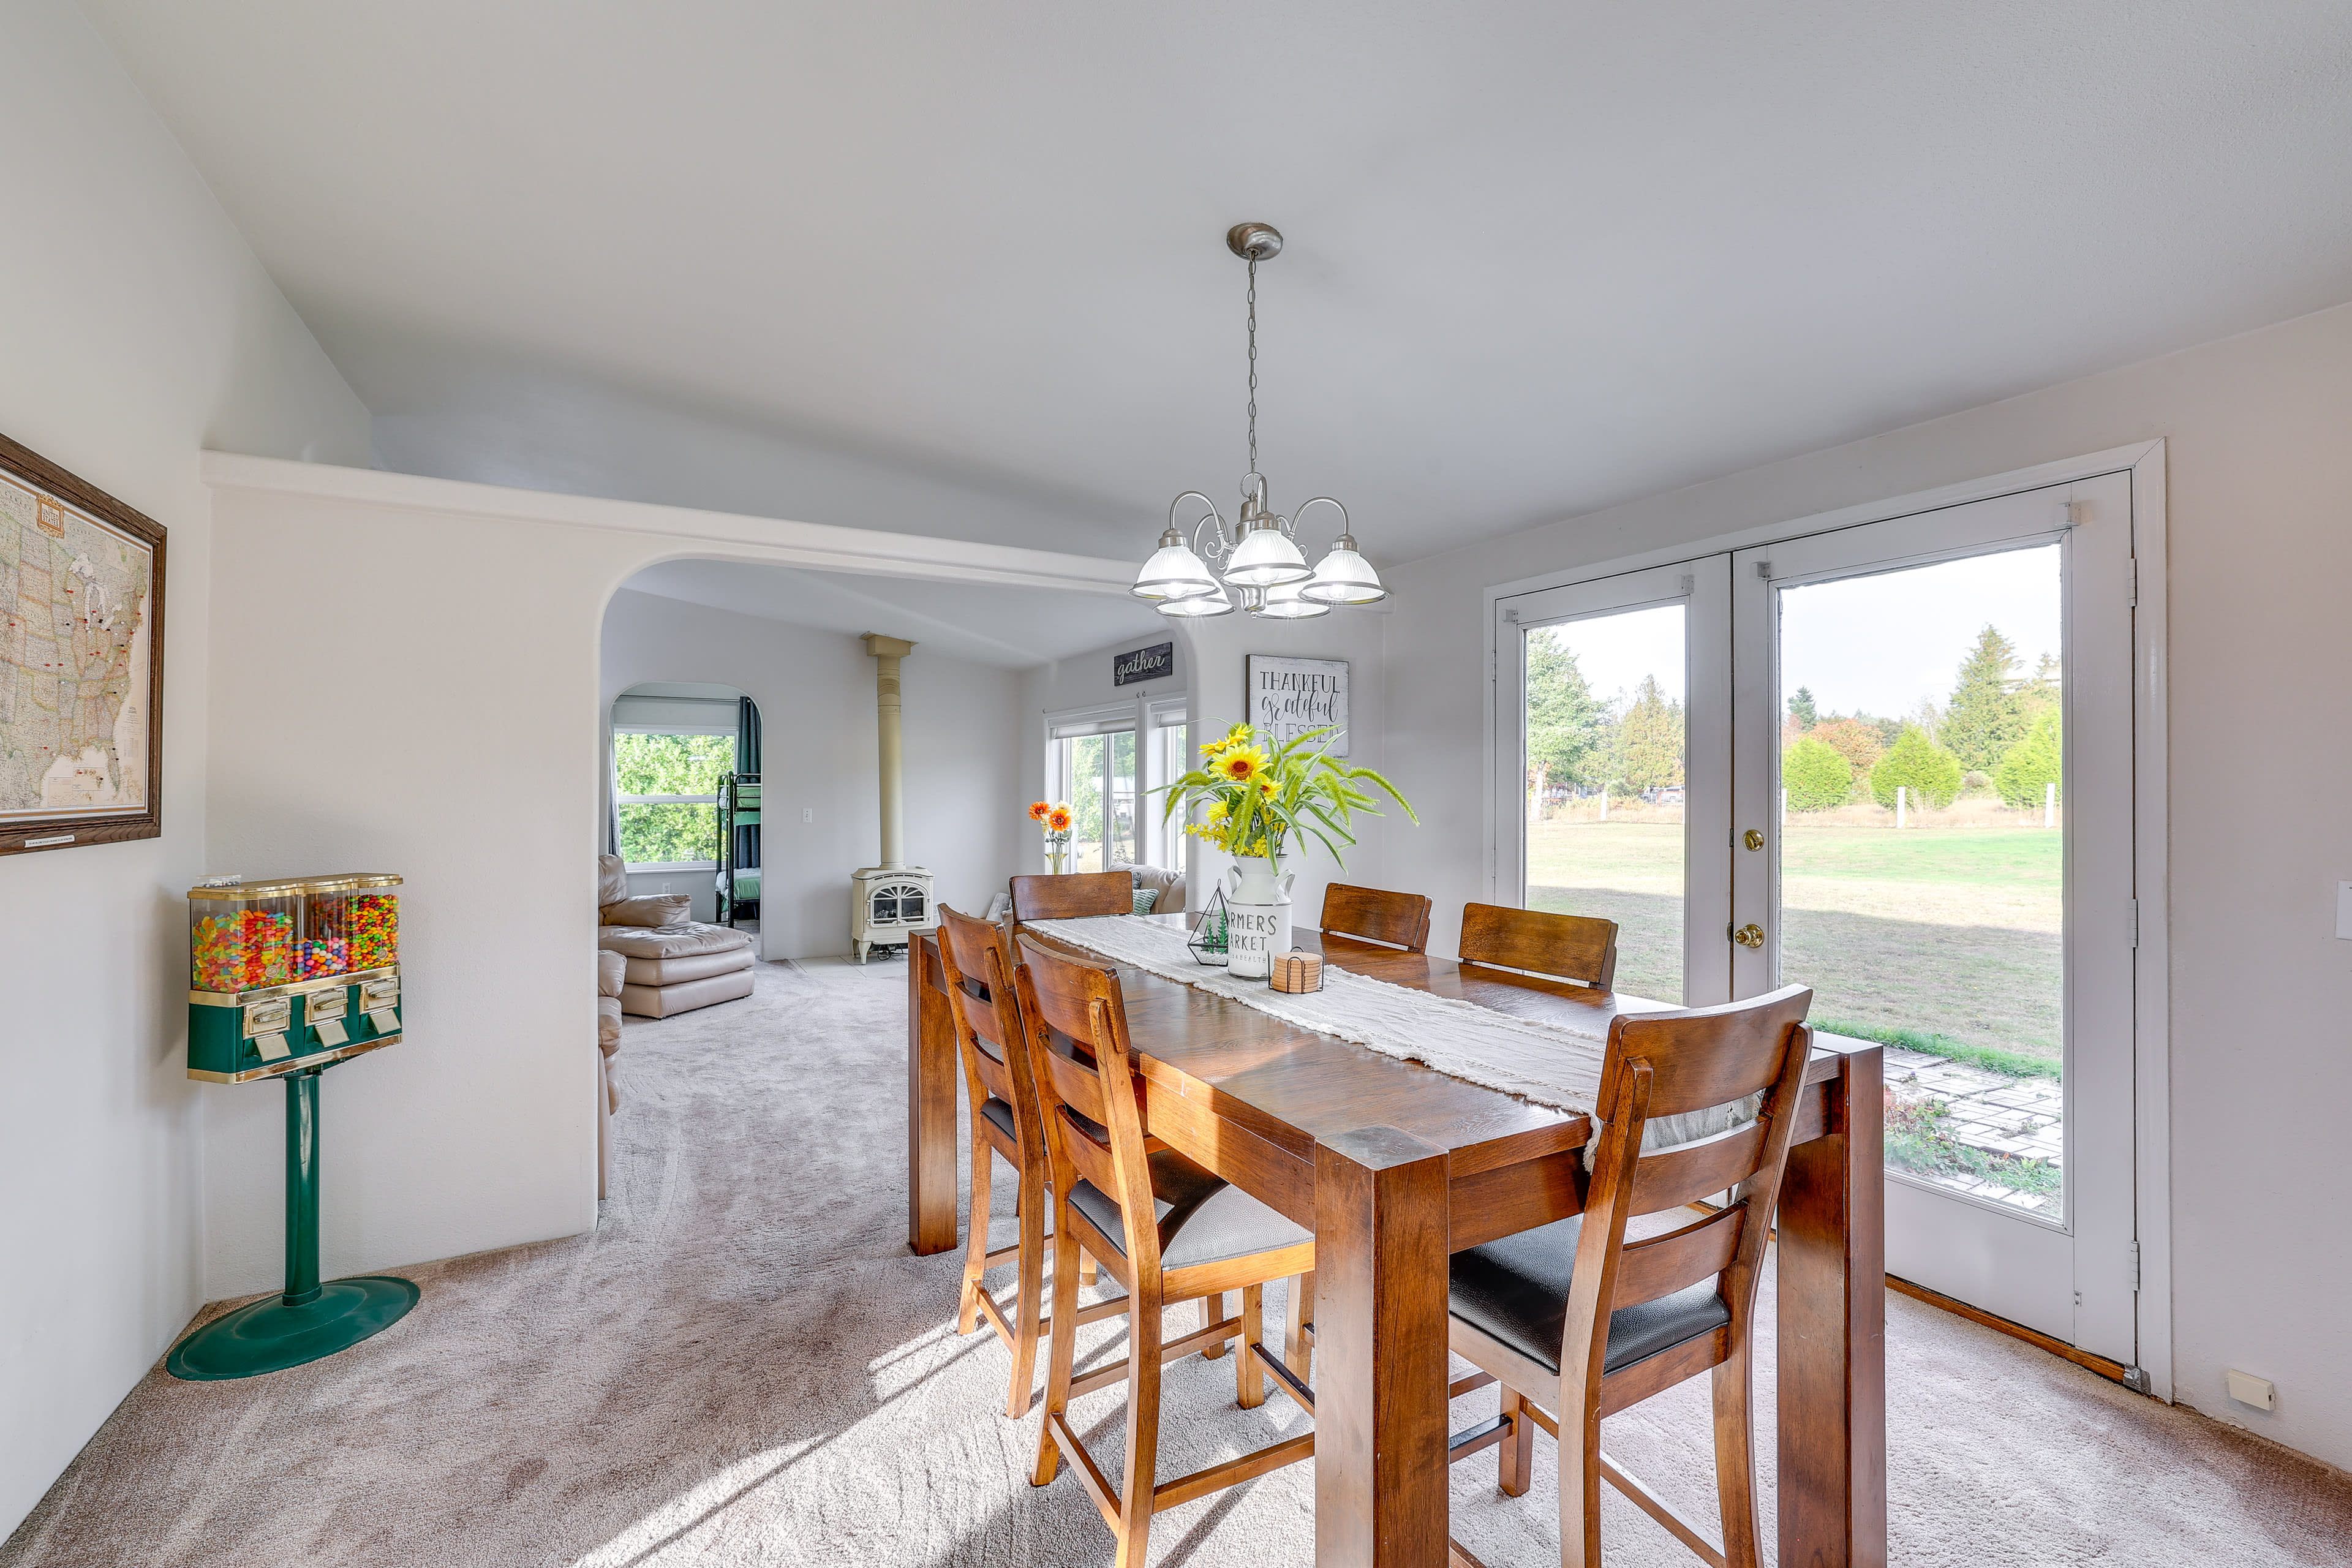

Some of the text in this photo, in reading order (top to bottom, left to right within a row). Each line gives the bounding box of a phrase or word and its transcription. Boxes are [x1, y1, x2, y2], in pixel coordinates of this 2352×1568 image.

[42, 508, 59, 521] UNITED
[43, 514, 59, 527] STATES
[1118, 650, 1165, 685] gather
[1260, 671, 1341, 694] THANKFUL
[1261, 689, 1338, 726] grateful
[1230, 933, 1267, 951] ARKET
